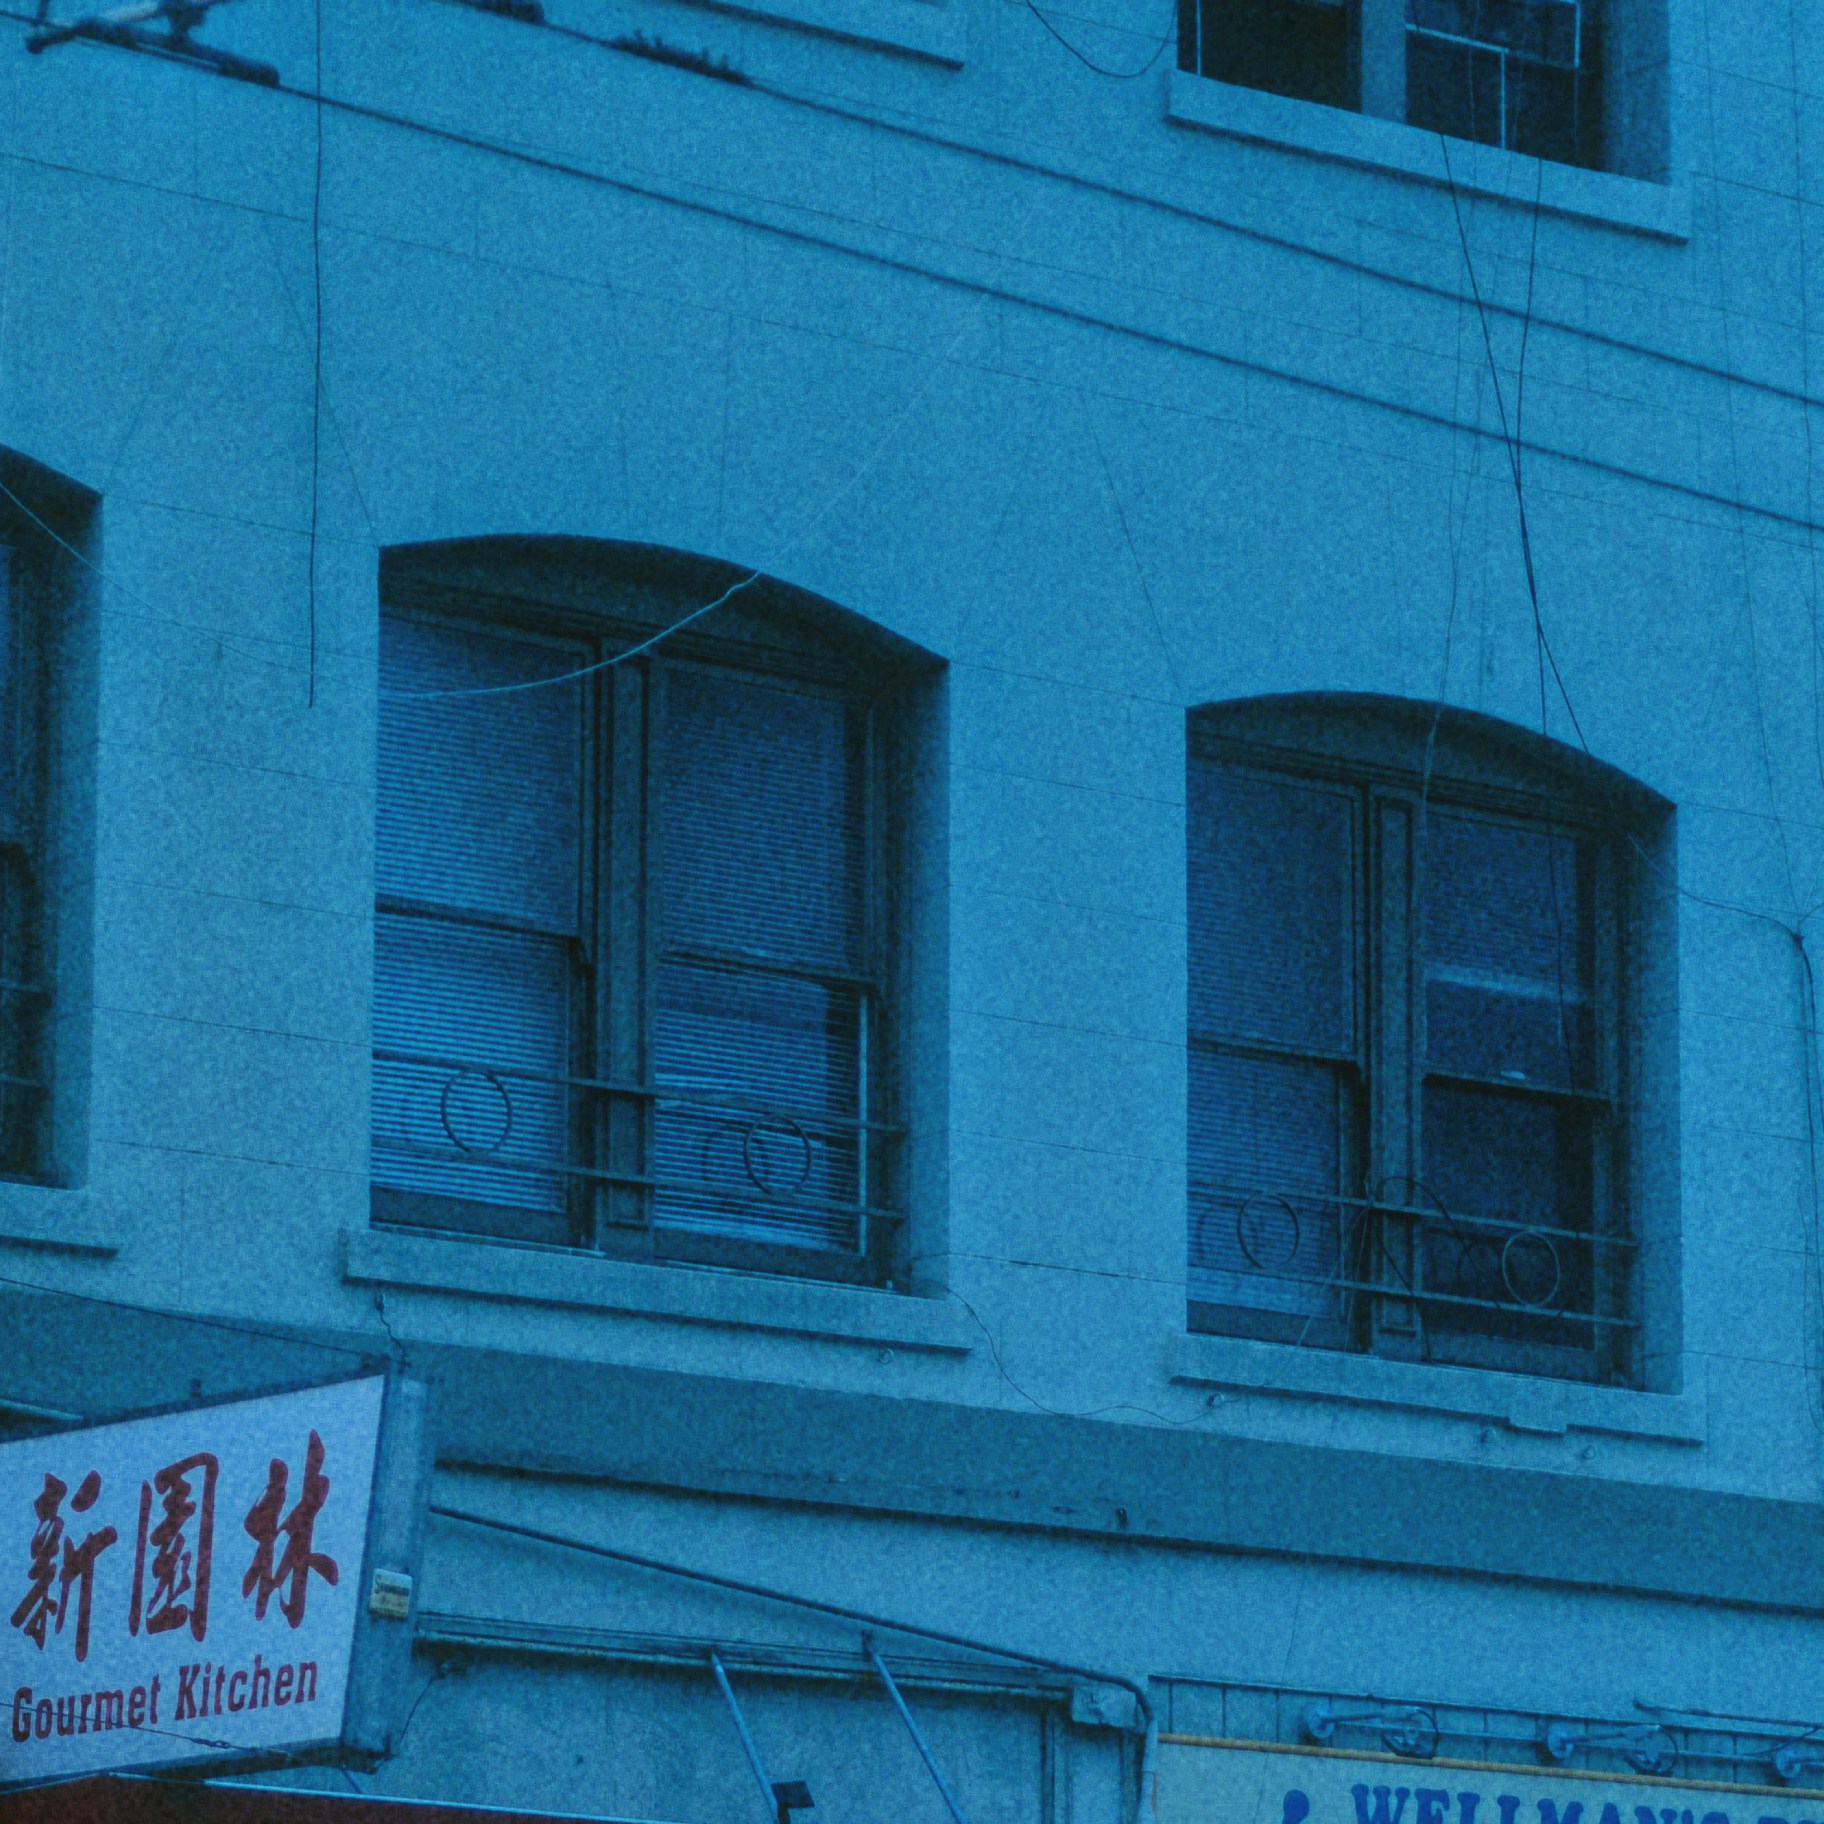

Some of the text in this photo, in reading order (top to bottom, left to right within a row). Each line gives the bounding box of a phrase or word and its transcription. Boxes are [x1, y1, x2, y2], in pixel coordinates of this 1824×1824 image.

[11, 1429, 338, 1662] 新園林
[11, 1654, 318, 1743] Gourmet Kitchen
